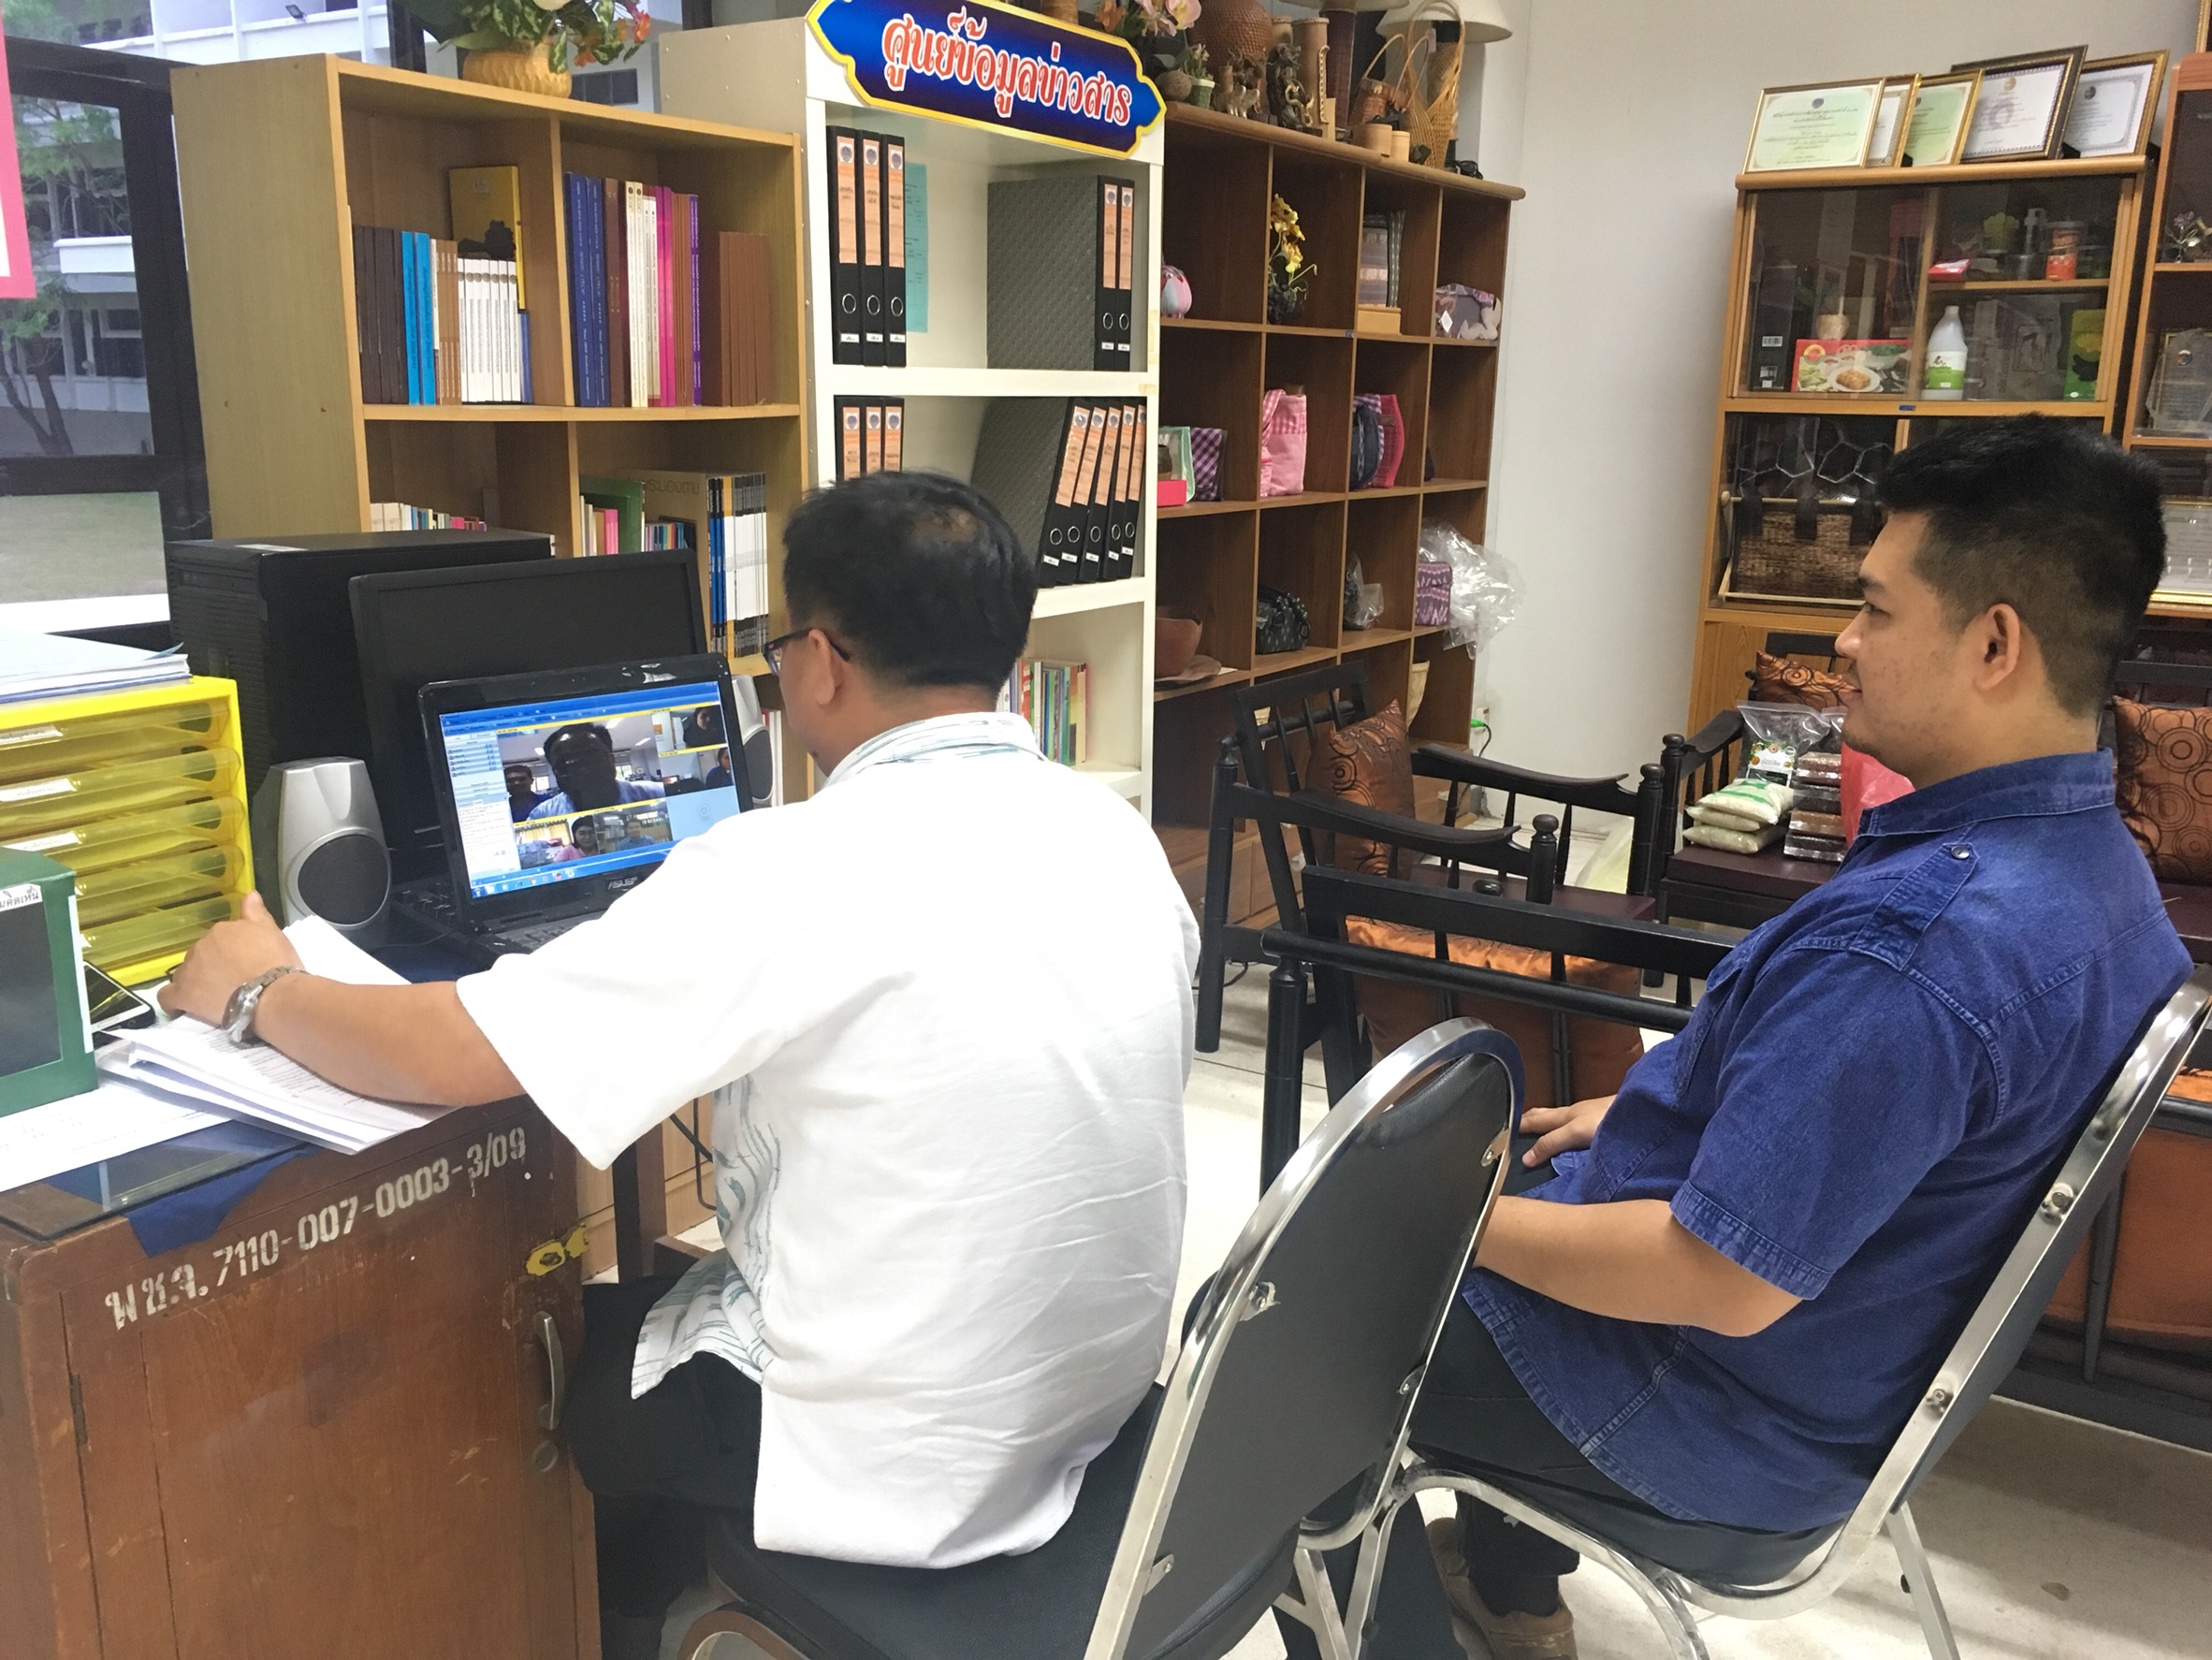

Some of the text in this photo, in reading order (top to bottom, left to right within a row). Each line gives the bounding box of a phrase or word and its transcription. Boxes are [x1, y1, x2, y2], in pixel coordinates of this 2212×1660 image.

[881, 7, 1132, 125] ศูนย์ข้อมูลข่าวสาร
